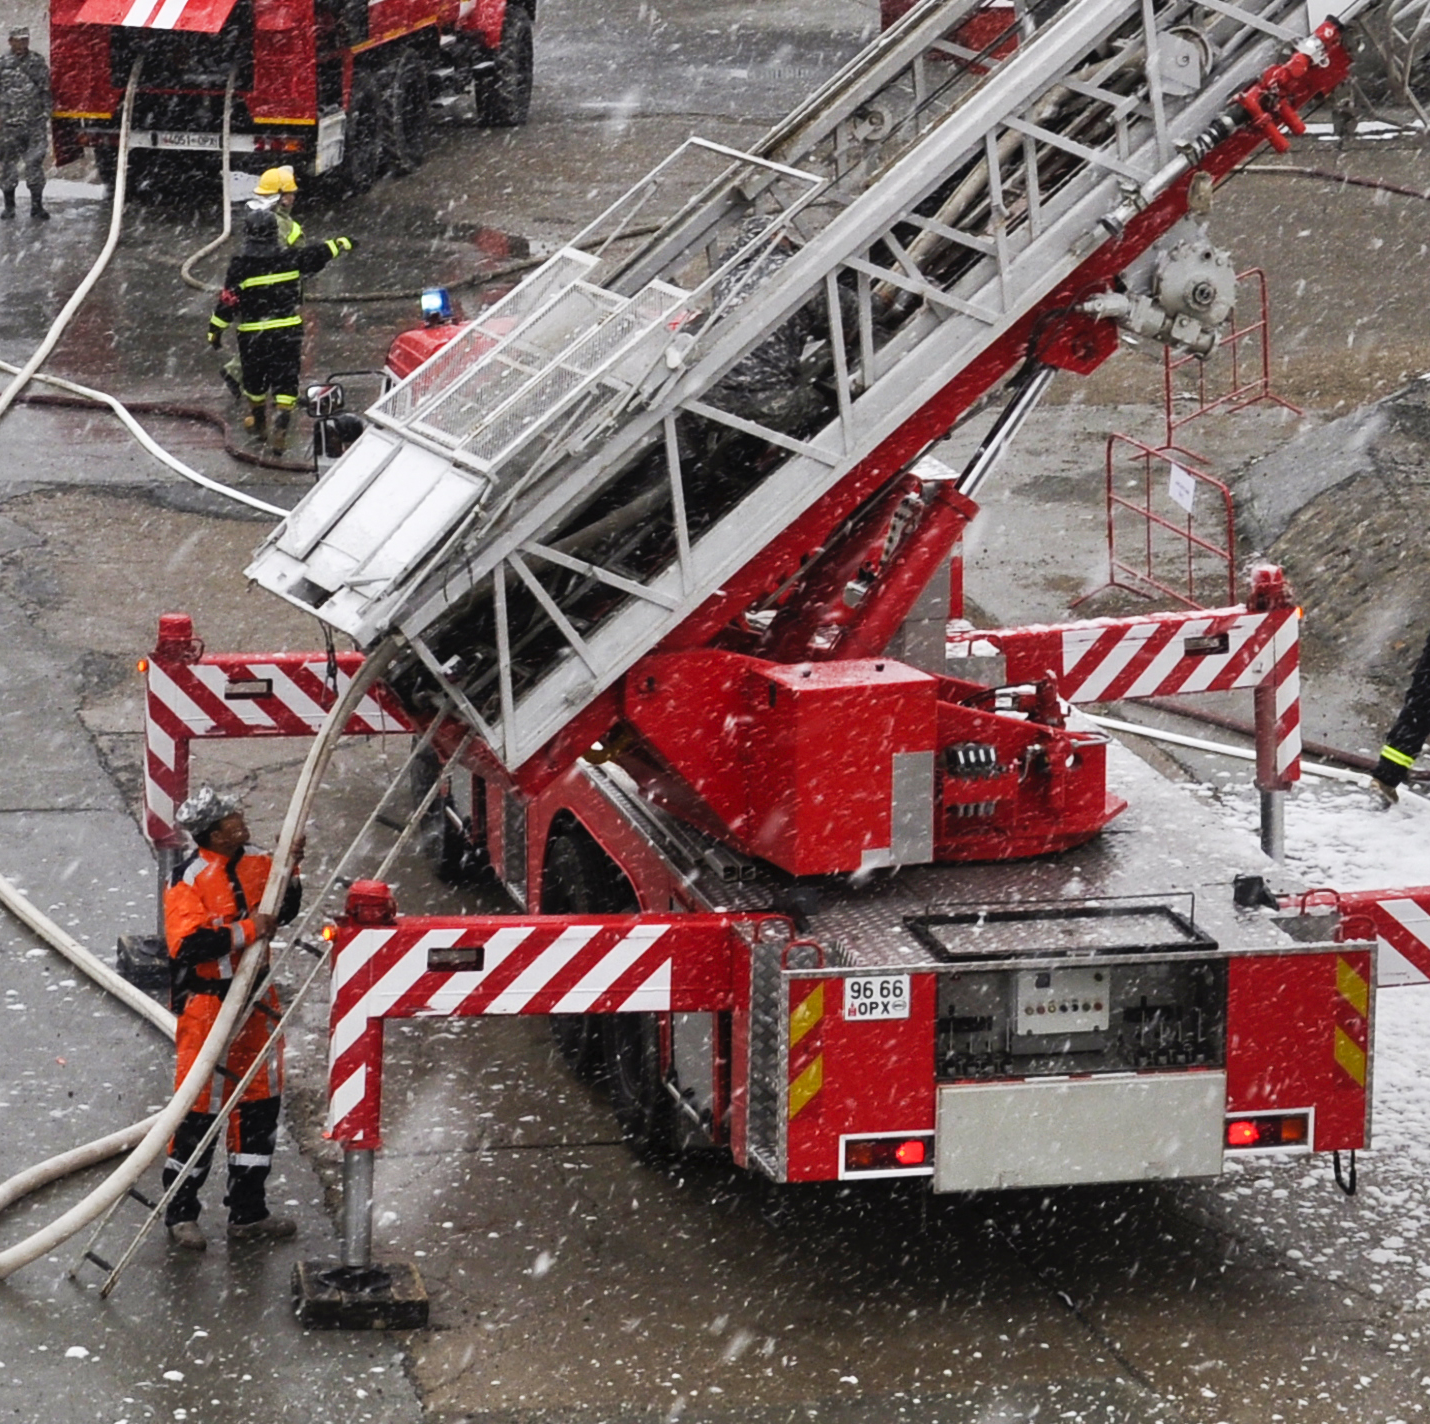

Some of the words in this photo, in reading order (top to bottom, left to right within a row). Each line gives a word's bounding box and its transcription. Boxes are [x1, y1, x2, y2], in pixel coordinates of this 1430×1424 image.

[850, 980, 874, 1000] 96
[879, 979, 904, 999] 66
[857, 1000, 891, 1016] ОРХ
